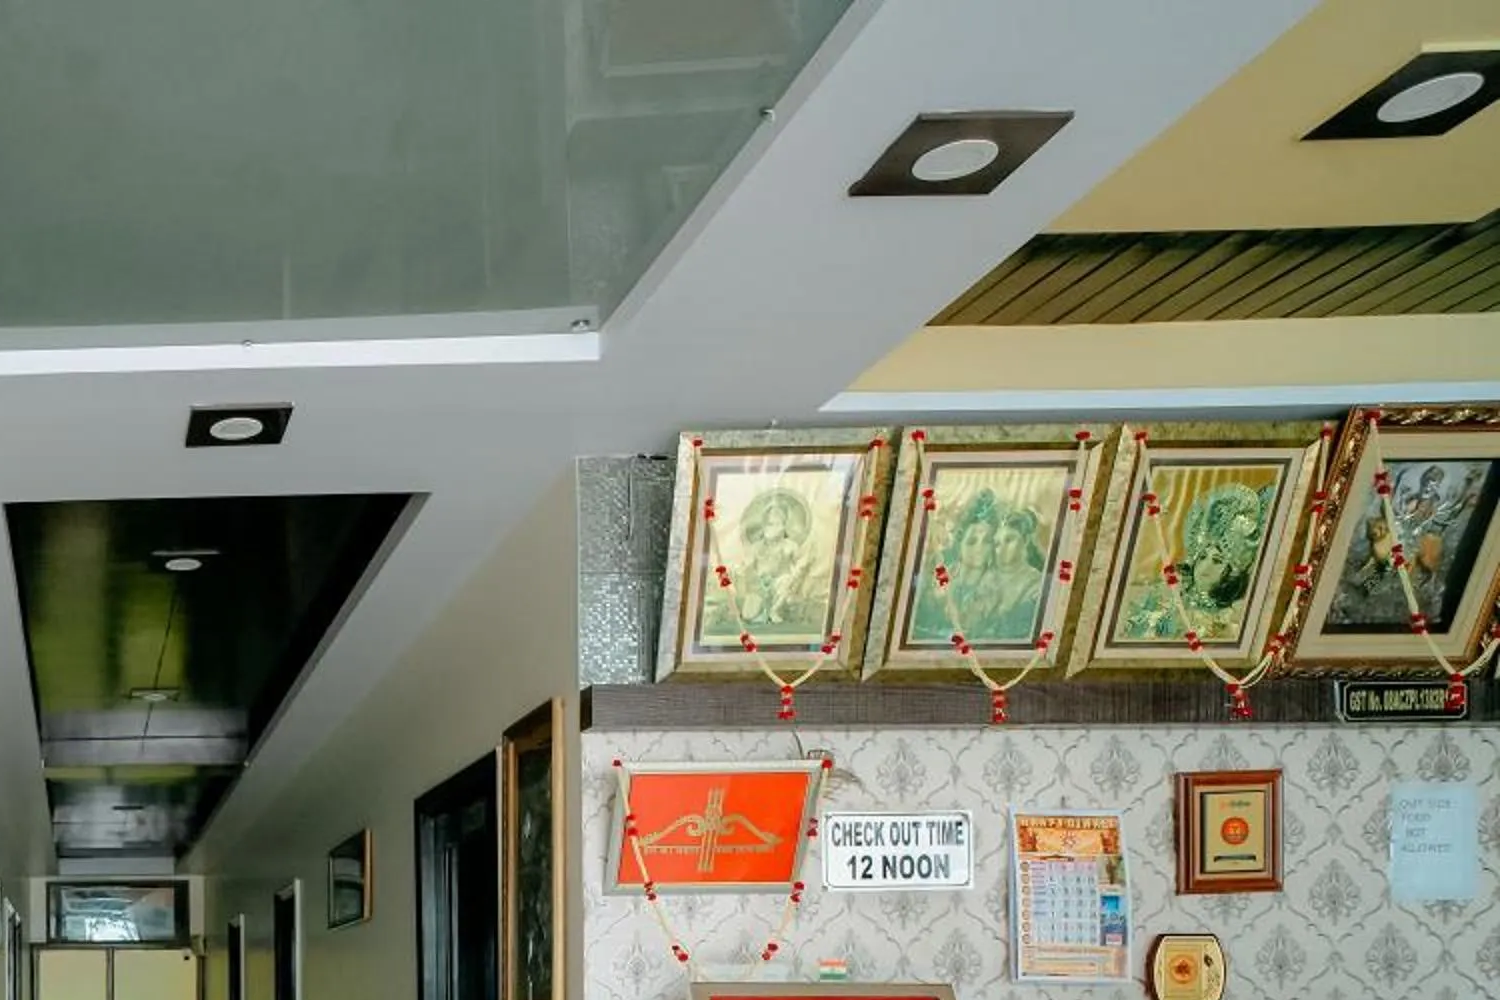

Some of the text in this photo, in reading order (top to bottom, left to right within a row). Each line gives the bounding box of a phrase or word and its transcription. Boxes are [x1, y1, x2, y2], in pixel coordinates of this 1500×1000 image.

[1349, 690, 1366, 711] GST
[832, 821, 964, 847] CHECK OUT TIME
[846, 854, 951, 880] 12 NOON
